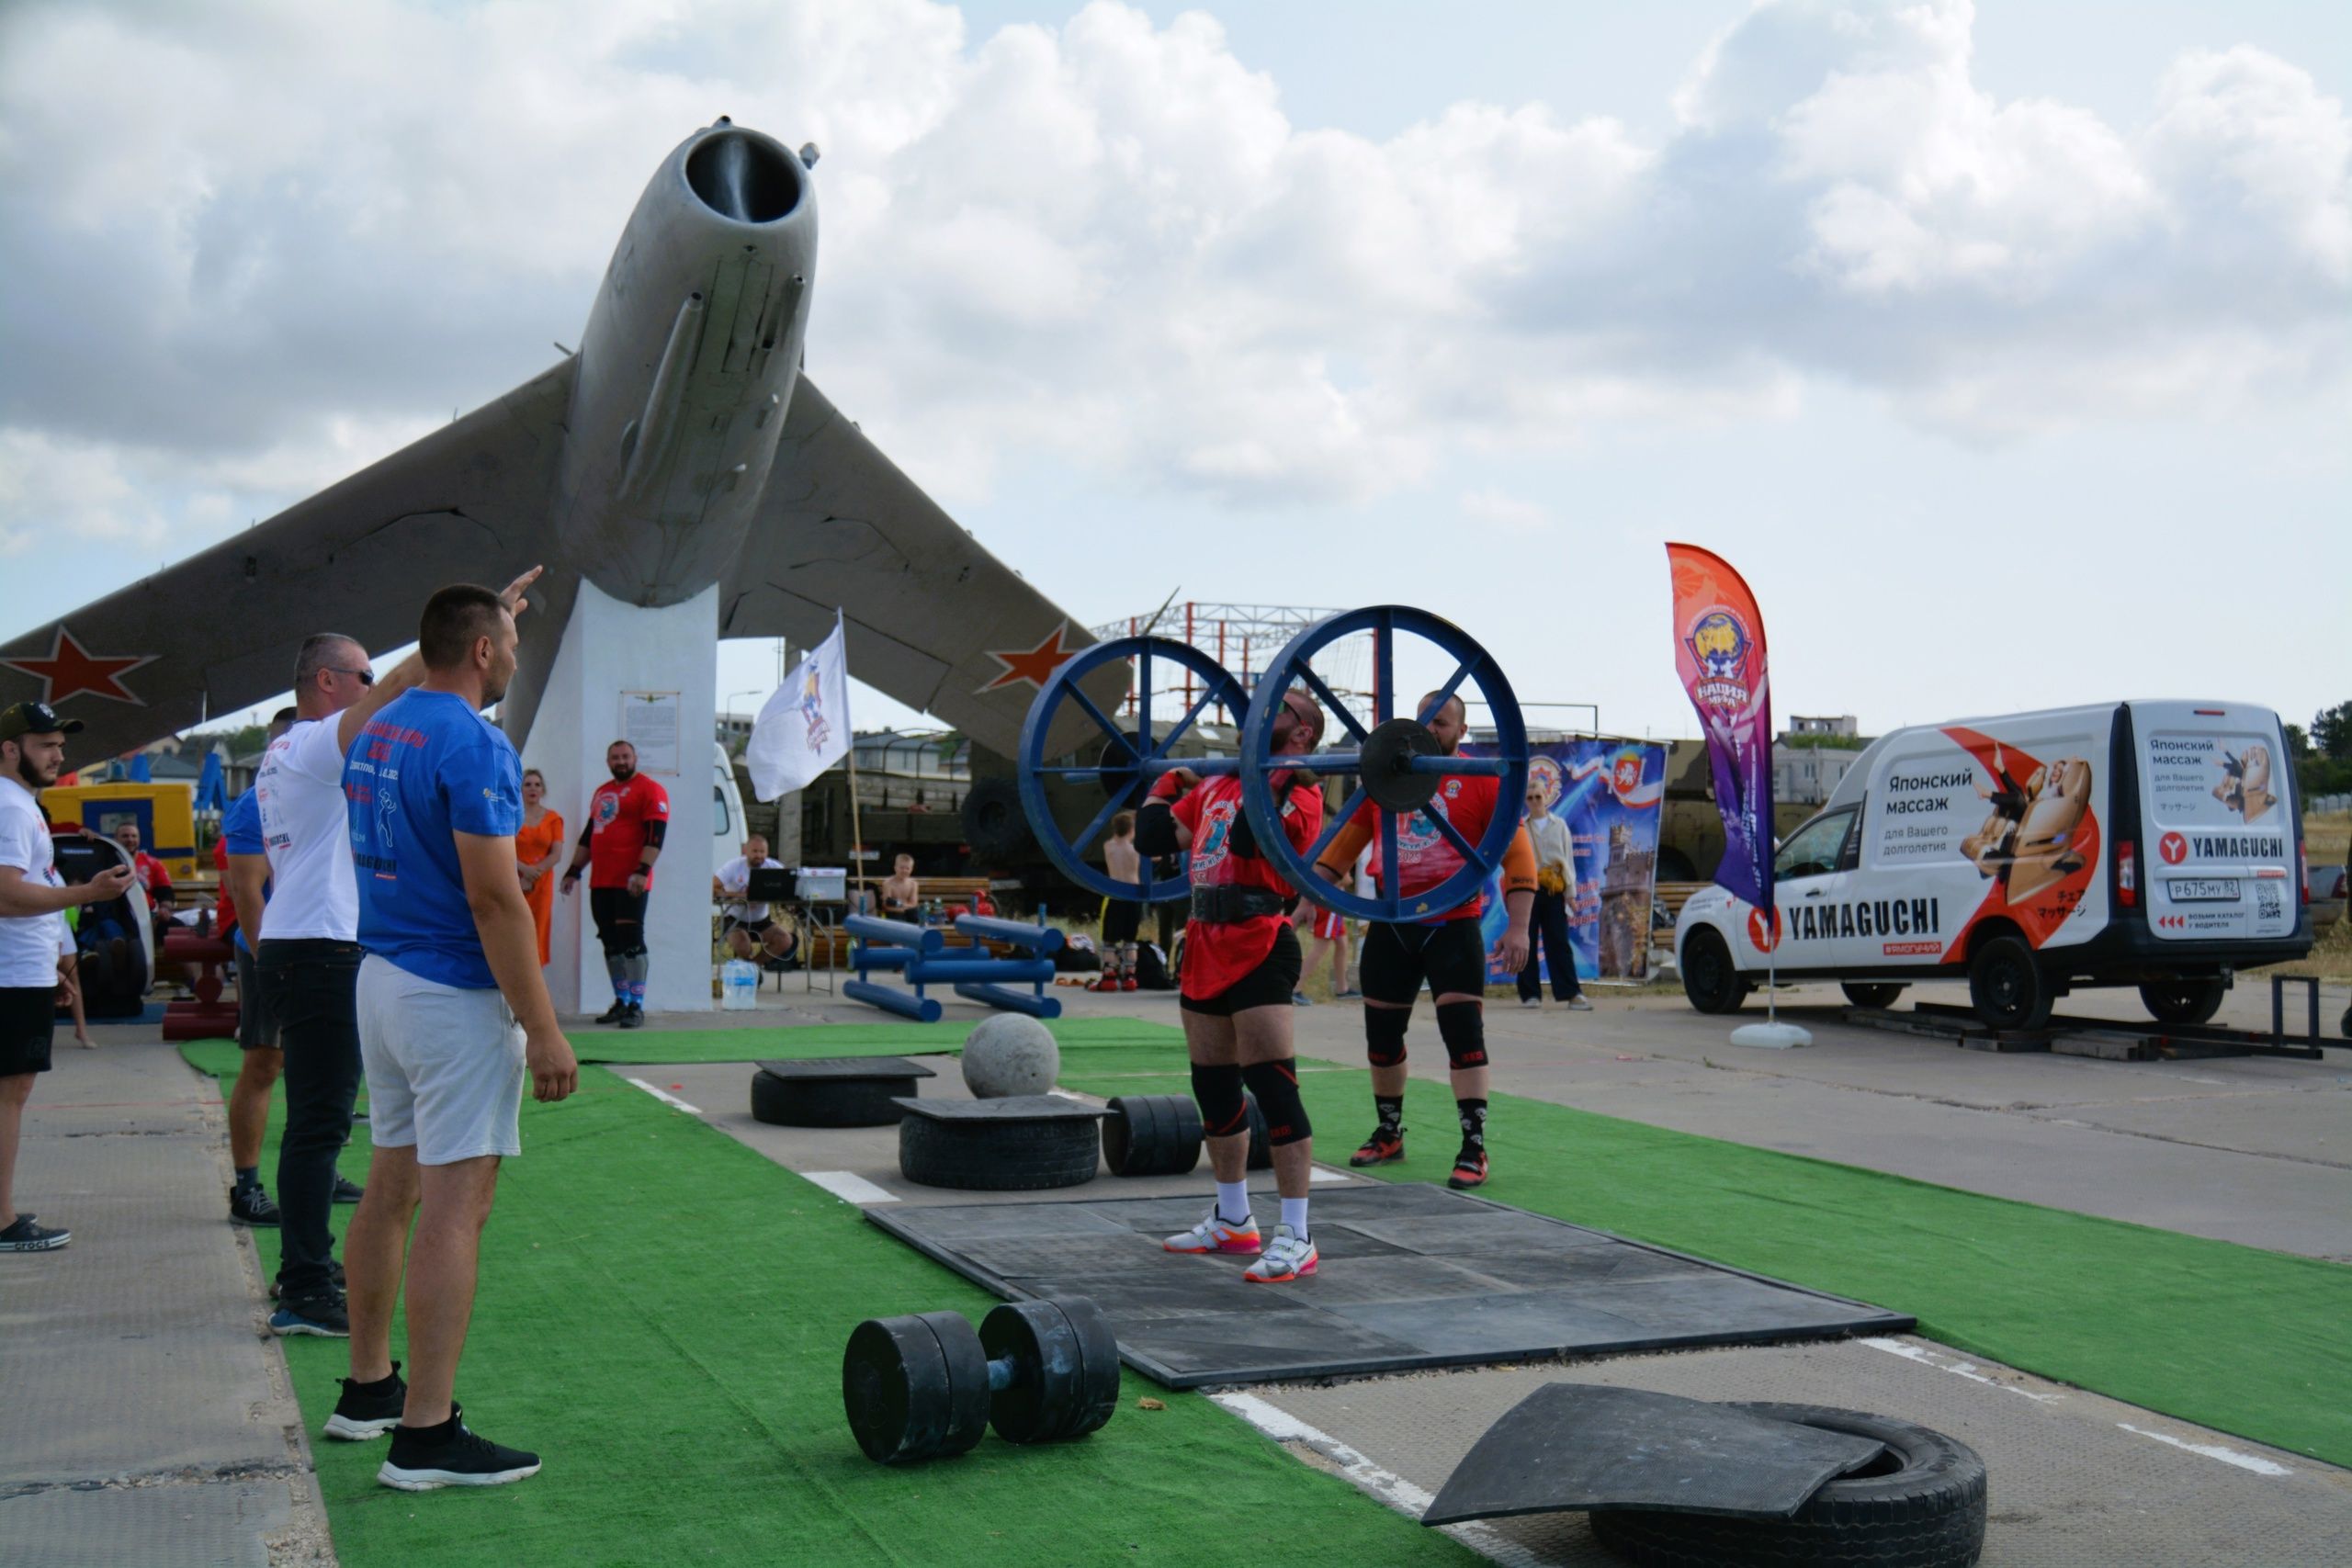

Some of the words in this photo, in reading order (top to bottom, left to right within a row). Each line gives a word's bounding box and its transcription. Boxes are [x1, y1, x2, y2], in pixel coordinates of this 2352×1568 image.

[2152, 739, 2213, 751] Японский
[2153, 755, 2202, 765] массаж
[1889, 768, 1973, 792] Японский
[1886, 797, 1949, 815] массаж
[1884, 829, 1904, 840] для
[1907, 827, 1949, 838] Вашего
[1883, 842, 1947, 856] долголетия
[2193, 838, 2283, 858] YAMAGUCHI
[1789, 897, 1939, 941] YAMAGUCHI
[15, 1240, 50, 1249] crocs
